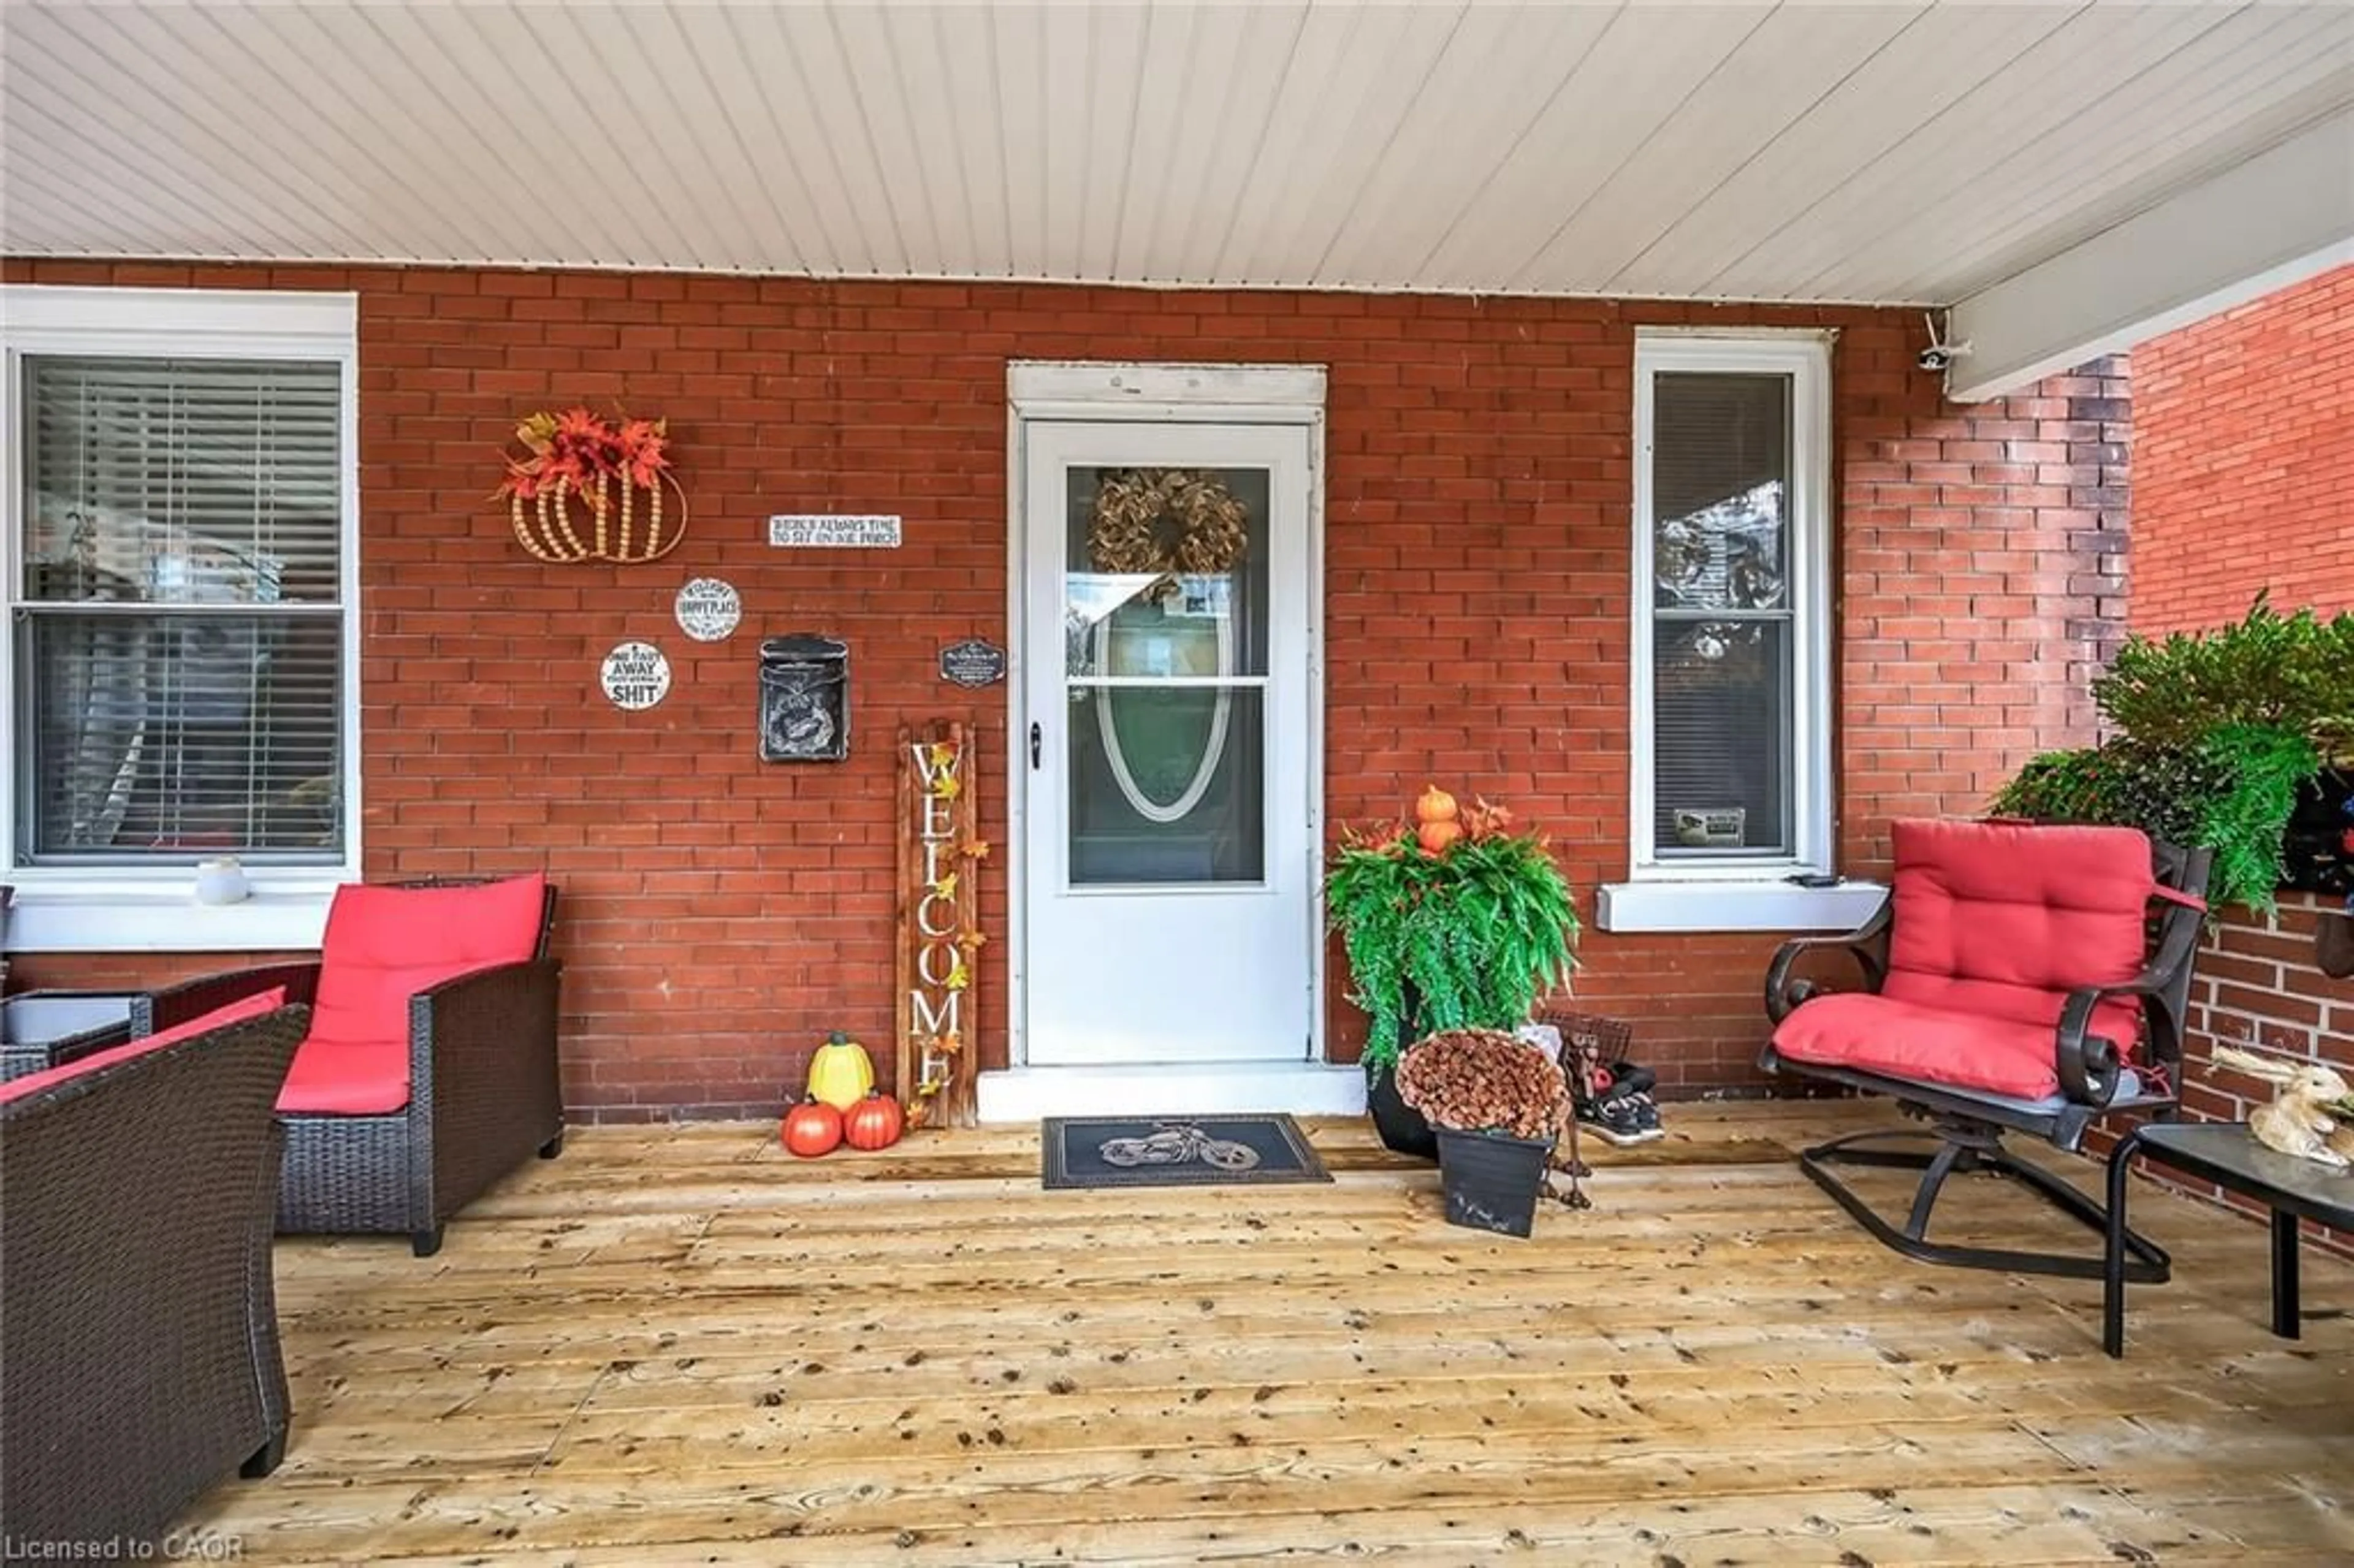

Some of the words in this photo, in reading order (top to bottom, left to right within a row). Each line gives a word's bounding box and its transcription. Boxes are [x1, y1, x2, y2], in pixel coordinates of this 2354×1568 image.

[773, 531, 789, 542] TO
[613, 662, 657, 674] AWAY
[614, 685, 658, 702] SHIT
[912, 744, 964, 1087] WELCOME
